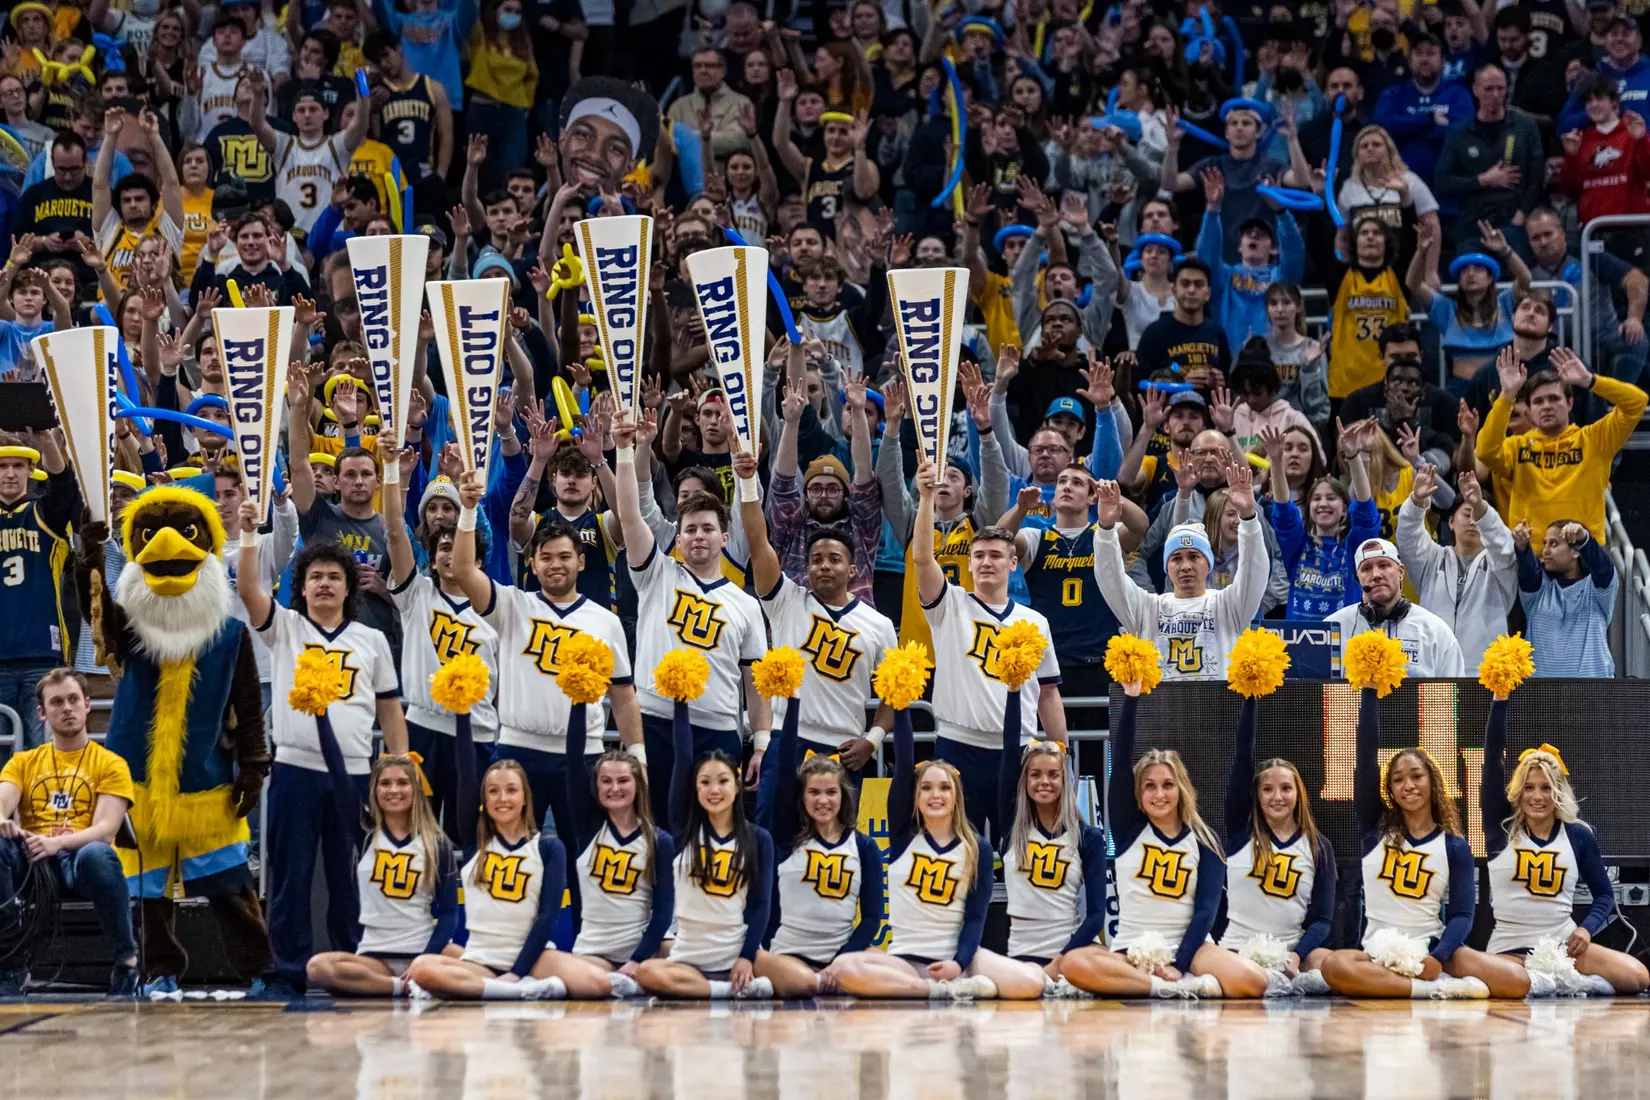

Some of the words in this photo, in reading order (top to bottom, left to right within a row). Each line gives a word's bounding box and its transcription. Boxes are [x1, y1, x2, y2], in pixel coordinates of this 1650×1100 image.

[1529, 31, 1548, 58] 3
[383, 100, 430, 124] MARQUETTE
[397, 120, 415, 144] 3
[218, 134, 272, 183] MU
[286, 164, 332, 185] MARQUETTE
[1583, 174, 1628, 189] HUSKIES
[34, 198, 93, 223] MARQUETT
[299, 182, 317, 209] 3
[821, 195, 837, 219] 3
[184, 213, 208, 231] MU
[596, 245, 638, 329] RING
[354, 265, 390, 350] RING
[372, 360, 393, 428] OUT
[459, 306, 499, 375] OUT
[696, 276, 741, 364] RING
[723, 371, 750, 441] OUT
[900, 298, 941, 384] RING
[224, 338, 265, 424] RING
[612, 338, 635, 407] OUT
[468, 386, 492, 469] RING
[240, 434, 262, 503] OUT
[0, 527, 40, 552] QUETTE
[1180, 535, 1194, 547] MU
[3, 555, 25, 587] 3
[1062, 577, 1083, 606] 0
[667, 588, 729, 651] MU
[801, 612, 864, 683] MU
[1167, 637, 1204, 674] MU
[52, 793, 71, 810] MU
[370, 848, 422, 900] MU
[480, 851, 533, 903] MU
[590, 843, 643, 896] MU
[801, 848, 855, 900] MU
[904, 851, 960, 906] MU
[1018, 840, 1071, 891] MU
[1136, 842, 1194, 899] MU
[1377, 845, 1435, 900] MU
[1511, 848, 1569, 898] MU
